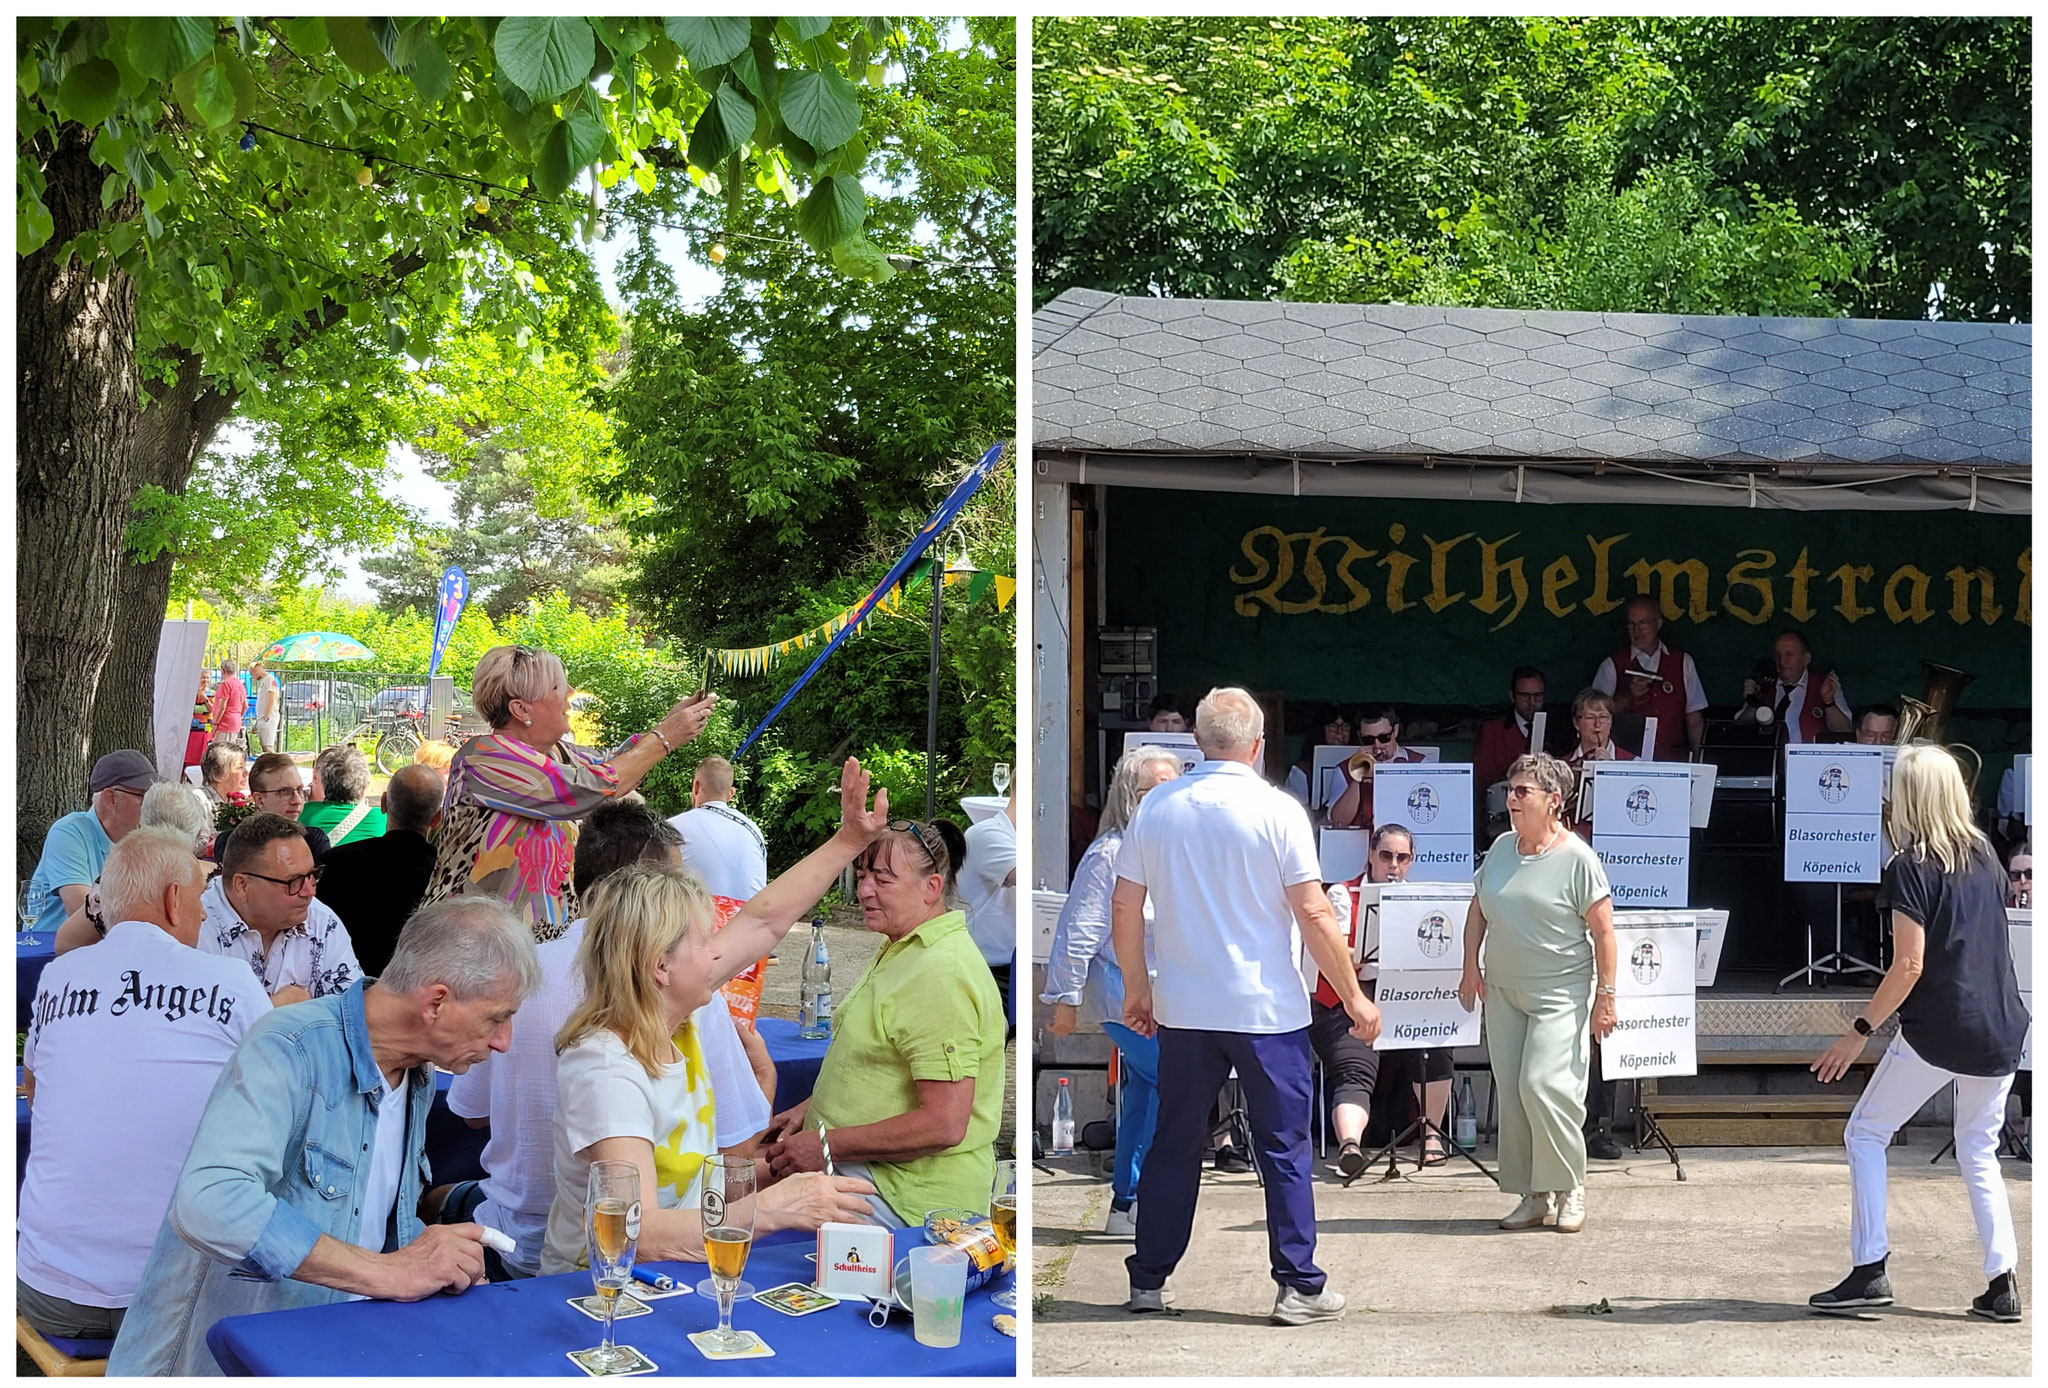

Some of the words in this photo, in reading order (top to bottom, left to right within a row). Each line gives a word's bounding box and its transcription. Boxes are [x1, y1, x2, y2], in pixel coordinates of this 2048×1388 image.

[1789, 829, 1877, 842] Blasorchester
[1411, 850, 1469, 863] rchester
[1597, 851, 1684, 865] Blasorchester
[1803, 861, 1861, 875] Köpenick
[1611, 884, 1668, 900] Köpenick
[111, 969, 235, 1025] Angels
[1380, 987, 1459, 1001] Blasorches
[1616, 1015, 1690, 1030] asorchester
[1394, 1021, 1459, 1040] Köpenick
[1619, 1051, 1676, 1070] Köpenick
[834, 1263, 876, 1273] Schultheiss
